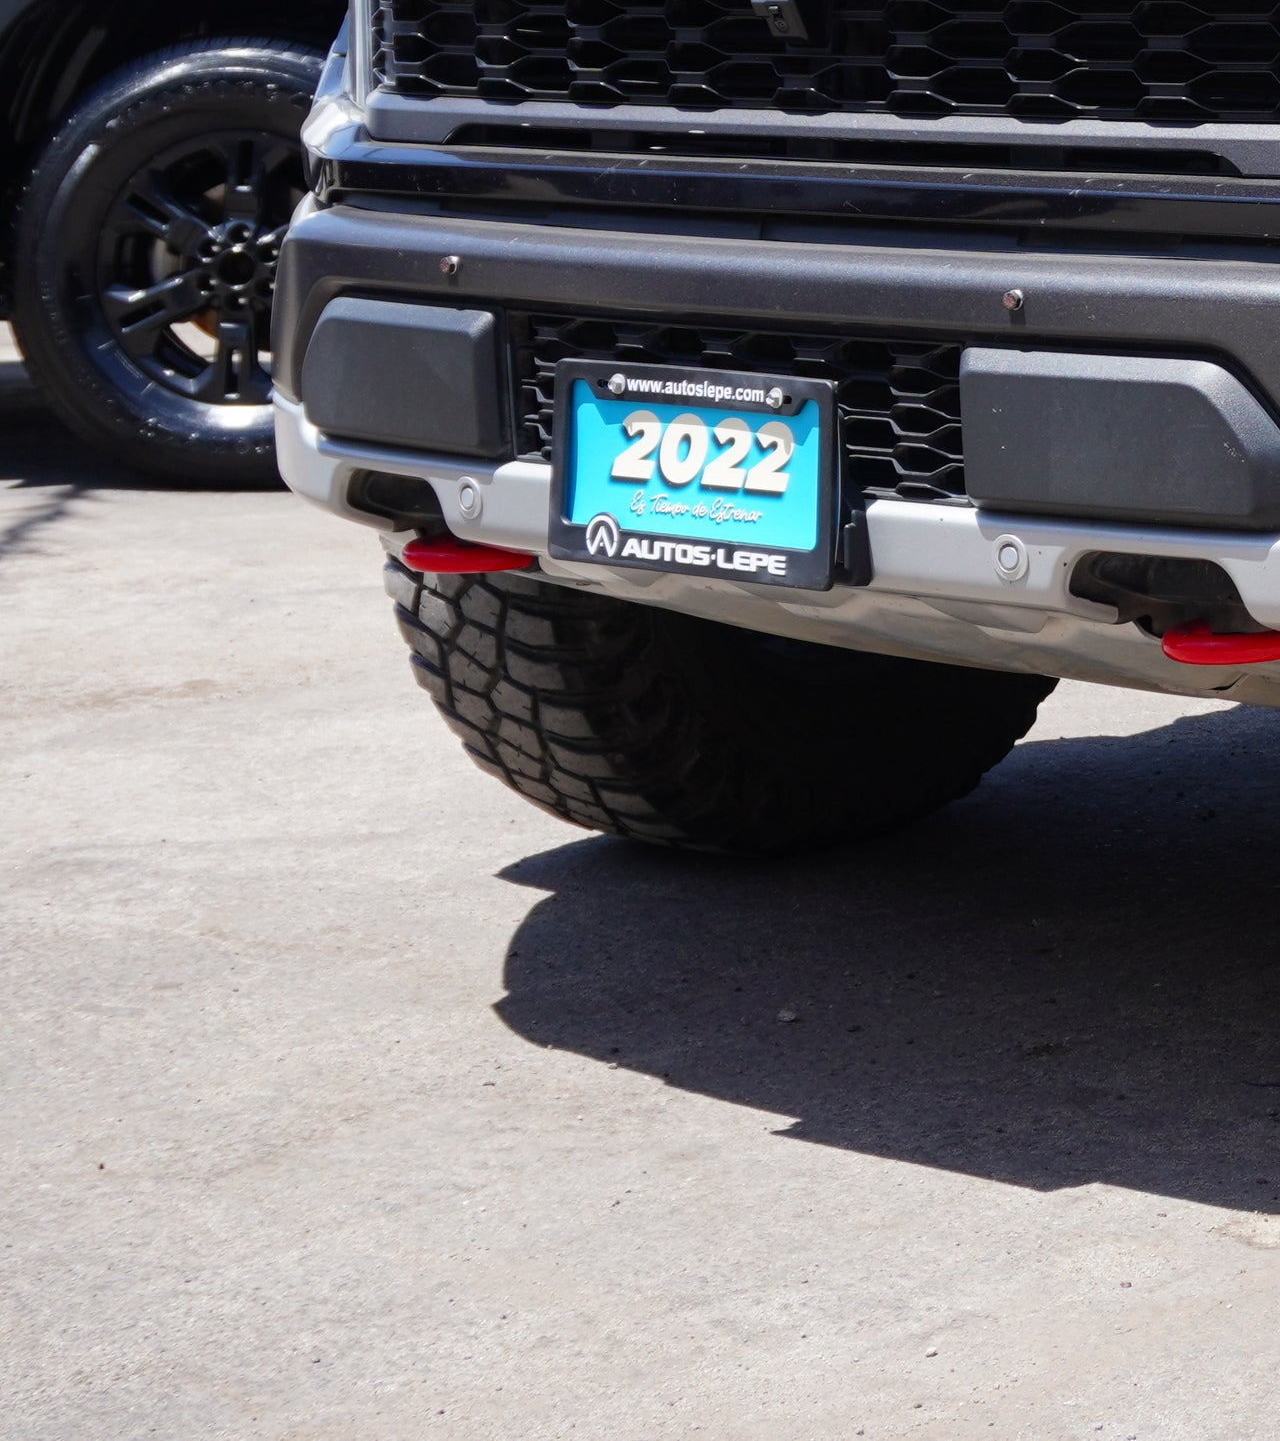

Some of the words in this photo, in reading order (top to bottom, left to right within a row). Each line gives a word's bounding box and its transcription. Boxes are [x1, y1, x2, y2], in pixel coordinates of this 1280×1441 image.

[625, 376, 765, 403] www.autoslepe.com
[610, 409, 795, 494] 2022
[630, 489, 646, 516] Es
[650, 493, 690, 518] Tiempo
[691, 501, 708, 518] de
[709, 498, 763, 524] Estrenar
